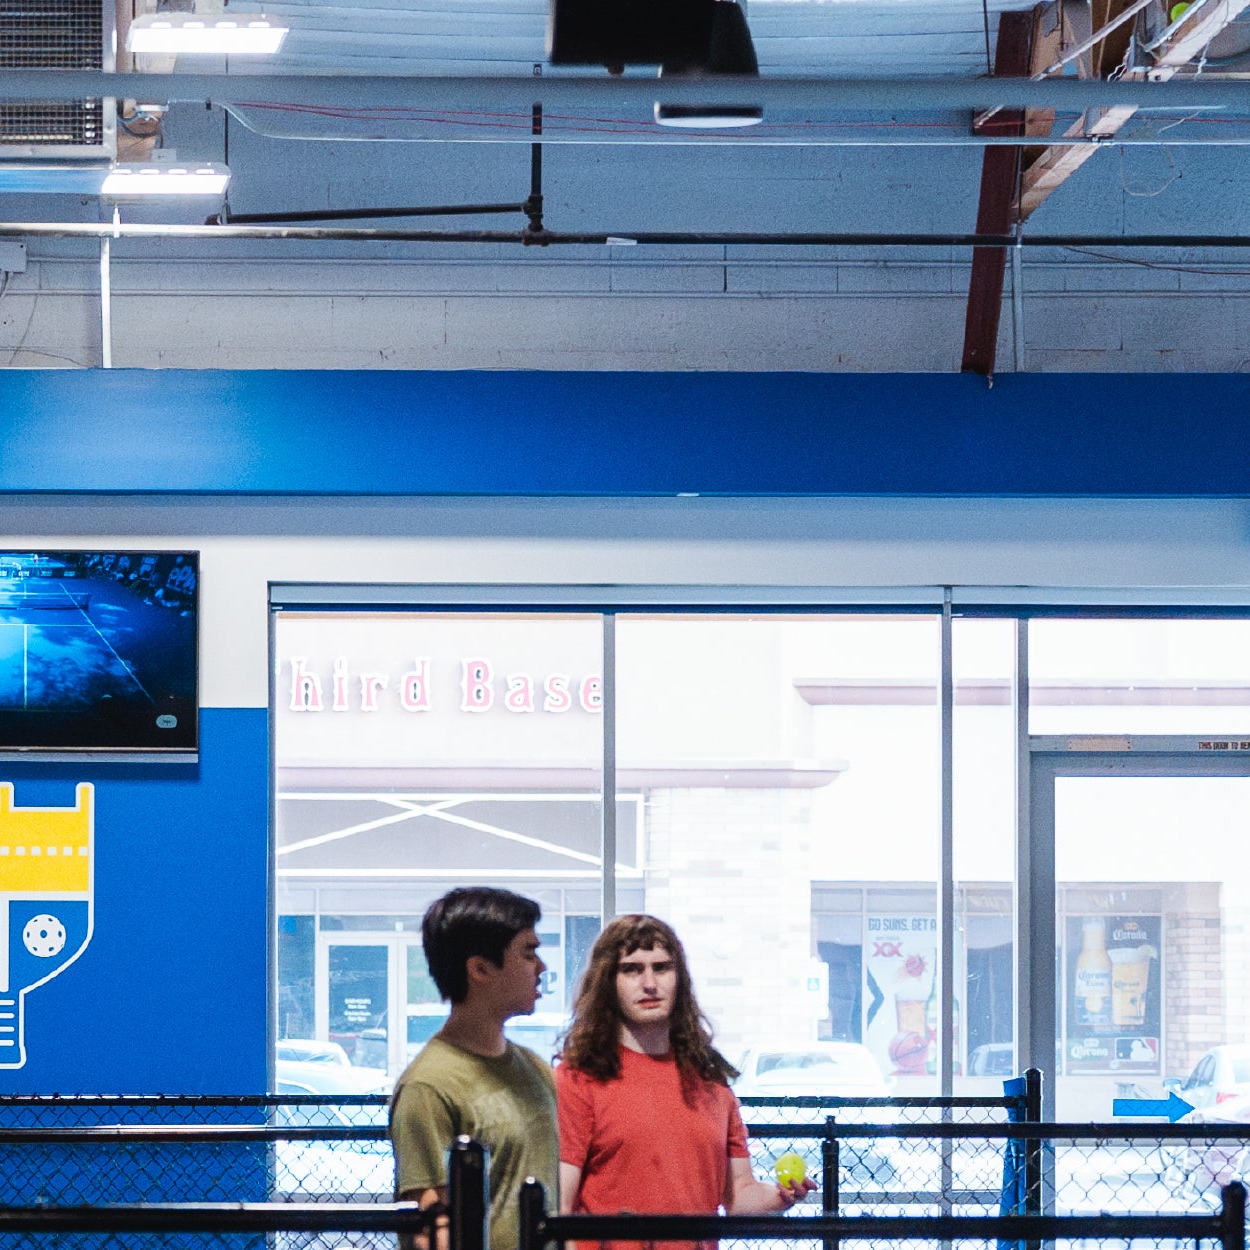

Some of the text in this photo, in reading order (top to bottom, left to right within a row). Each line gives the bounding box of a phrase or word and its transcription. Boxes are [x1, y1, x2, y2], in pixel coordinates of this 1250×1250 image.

[276, 656, 602, 713] hird Base
[868, 918, 881, 931] GO
[884, 918, 910, 931] SUNS.
[912, 918, 929, 931] GET
[1113, 929, 1147, 941] Corona
